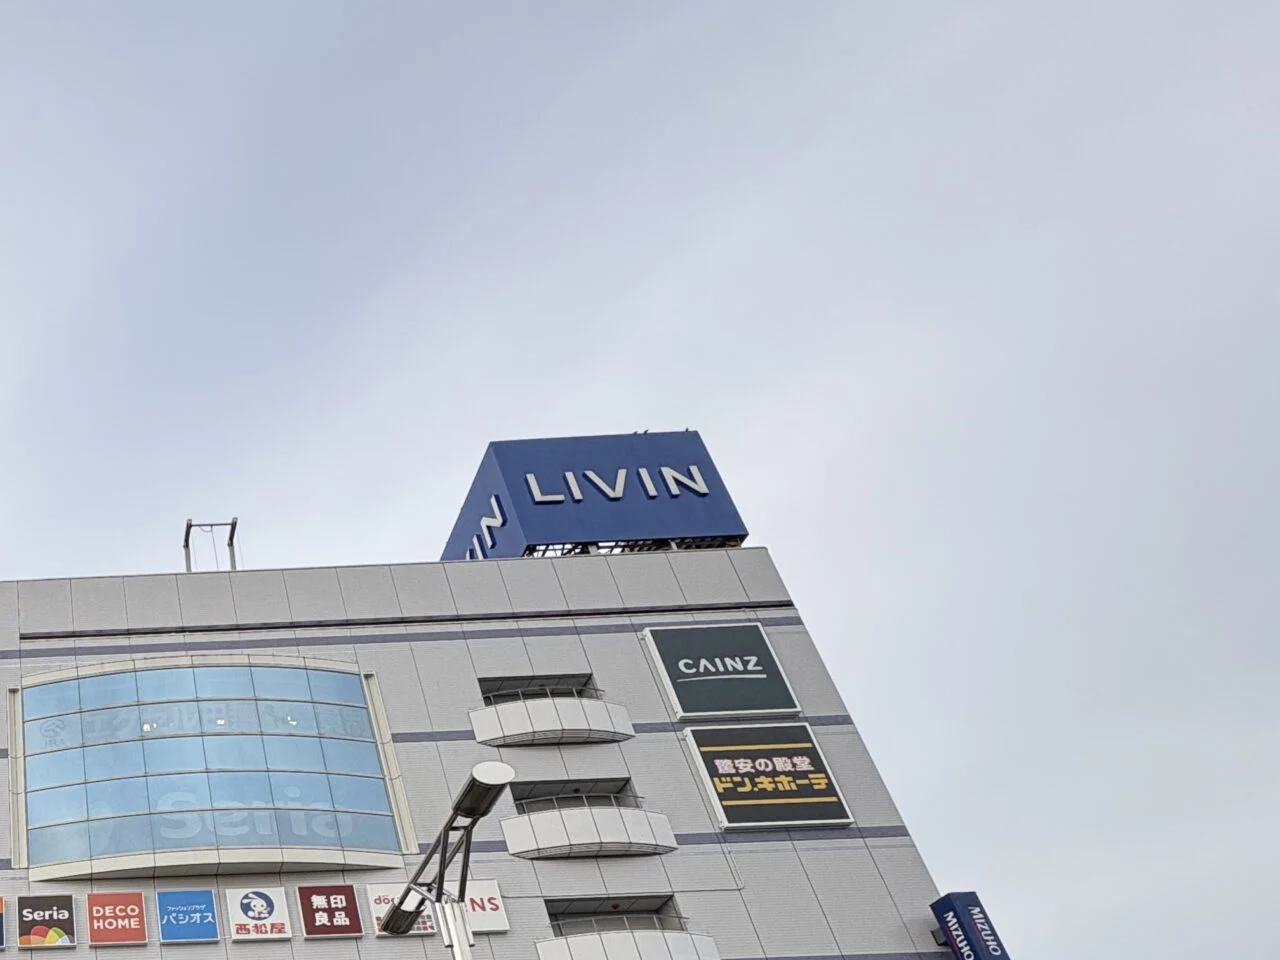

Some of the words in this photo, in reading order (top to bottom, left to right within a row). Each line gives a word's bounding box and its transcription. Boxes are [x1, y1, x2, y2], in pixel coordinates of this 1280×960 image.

[525, 464, 710, 503] LIVIN
[677, 656, 763, 674] CAINZ
[714, 756, 815, 774] 驚安の殿堂
[156, 786, 354, 840] Seria
[310, 894, 347, 909] 無印
[22, 906, 69, 922] Seria
[92, 905, 140, 917] DECO
[161, 912, 215, 925] パシオス
[93, 918, 141, 930] HOME
[314, 912, 350, 927] 良品
[235, 923, 287, 935] 西松屋
[968, 906, 1002, 956] MIZUHO
